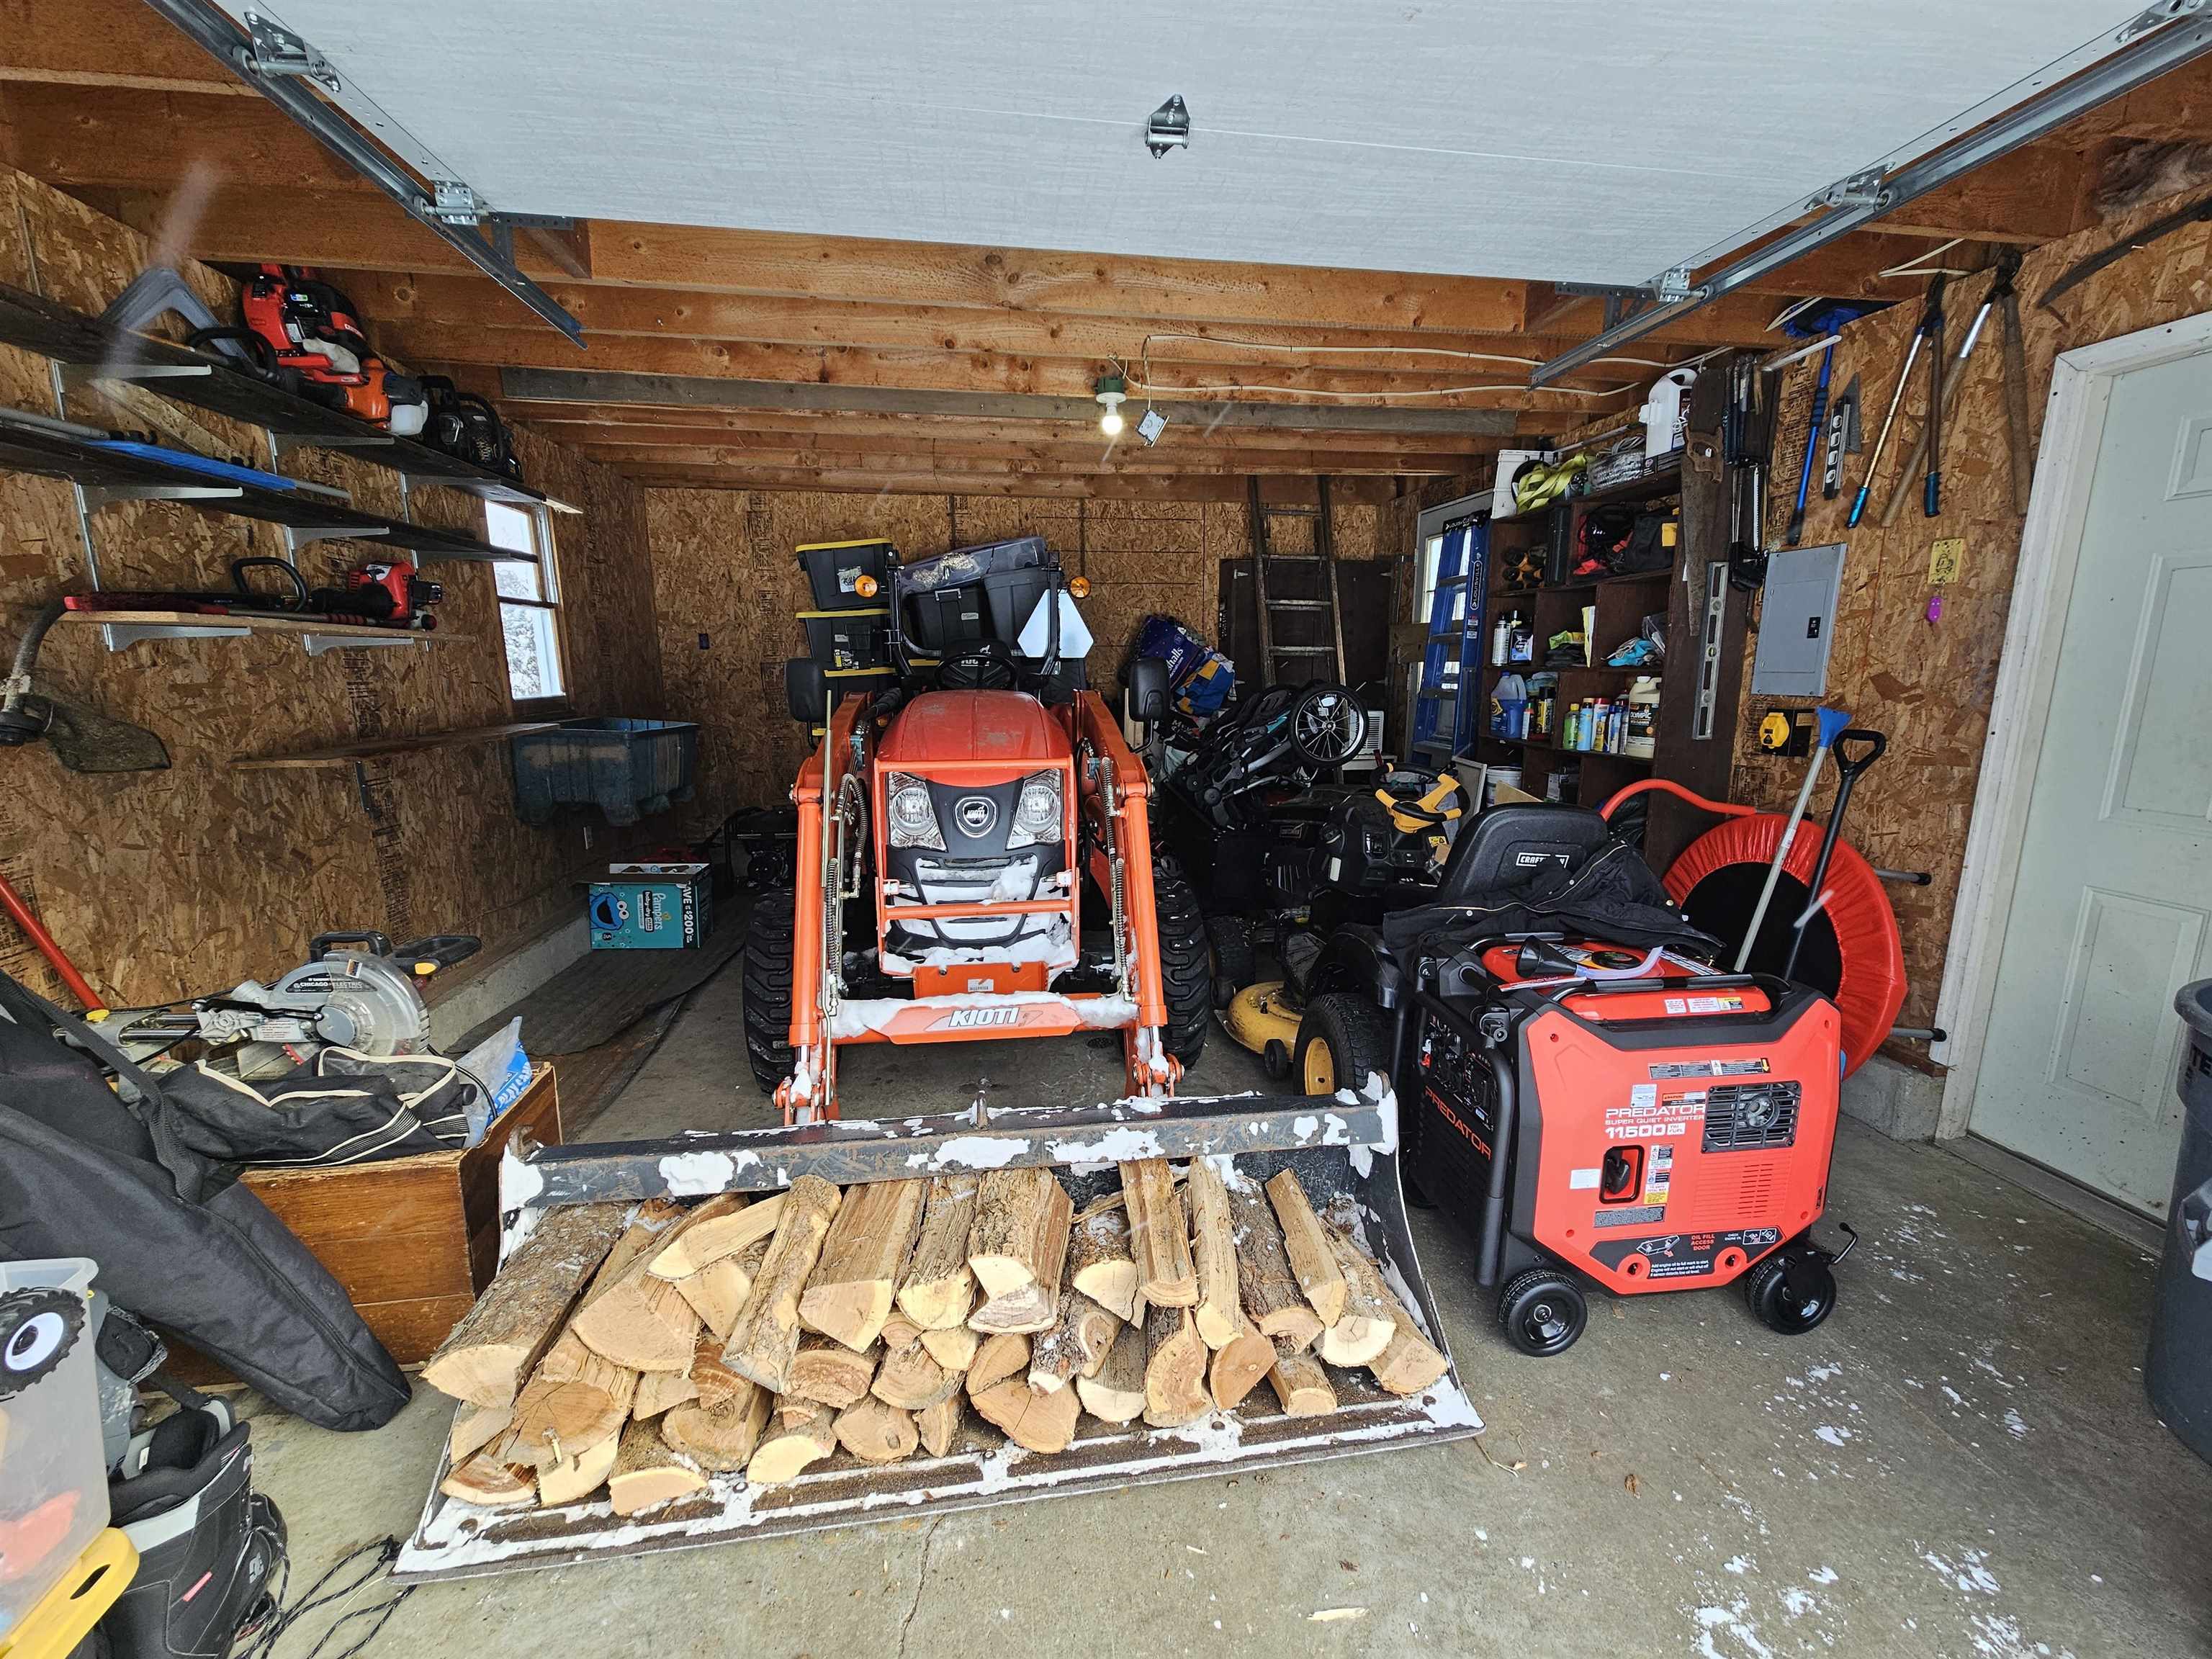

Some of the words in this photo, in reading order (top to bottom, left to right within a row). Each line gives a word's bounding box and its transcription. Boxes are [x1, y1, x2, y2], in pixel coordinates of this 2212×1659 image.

[1166, 646, 1184, 671] shalls
[966, 809, 985, 819] KIOTI
[652, 893, 667, 930] Pampers
[948, 1007, 1020, 1028] KIOTI
[1605, 1103, 1706, 1118] PREDATOR
[1425, 1084, 1493, 1161] PREDATOR
